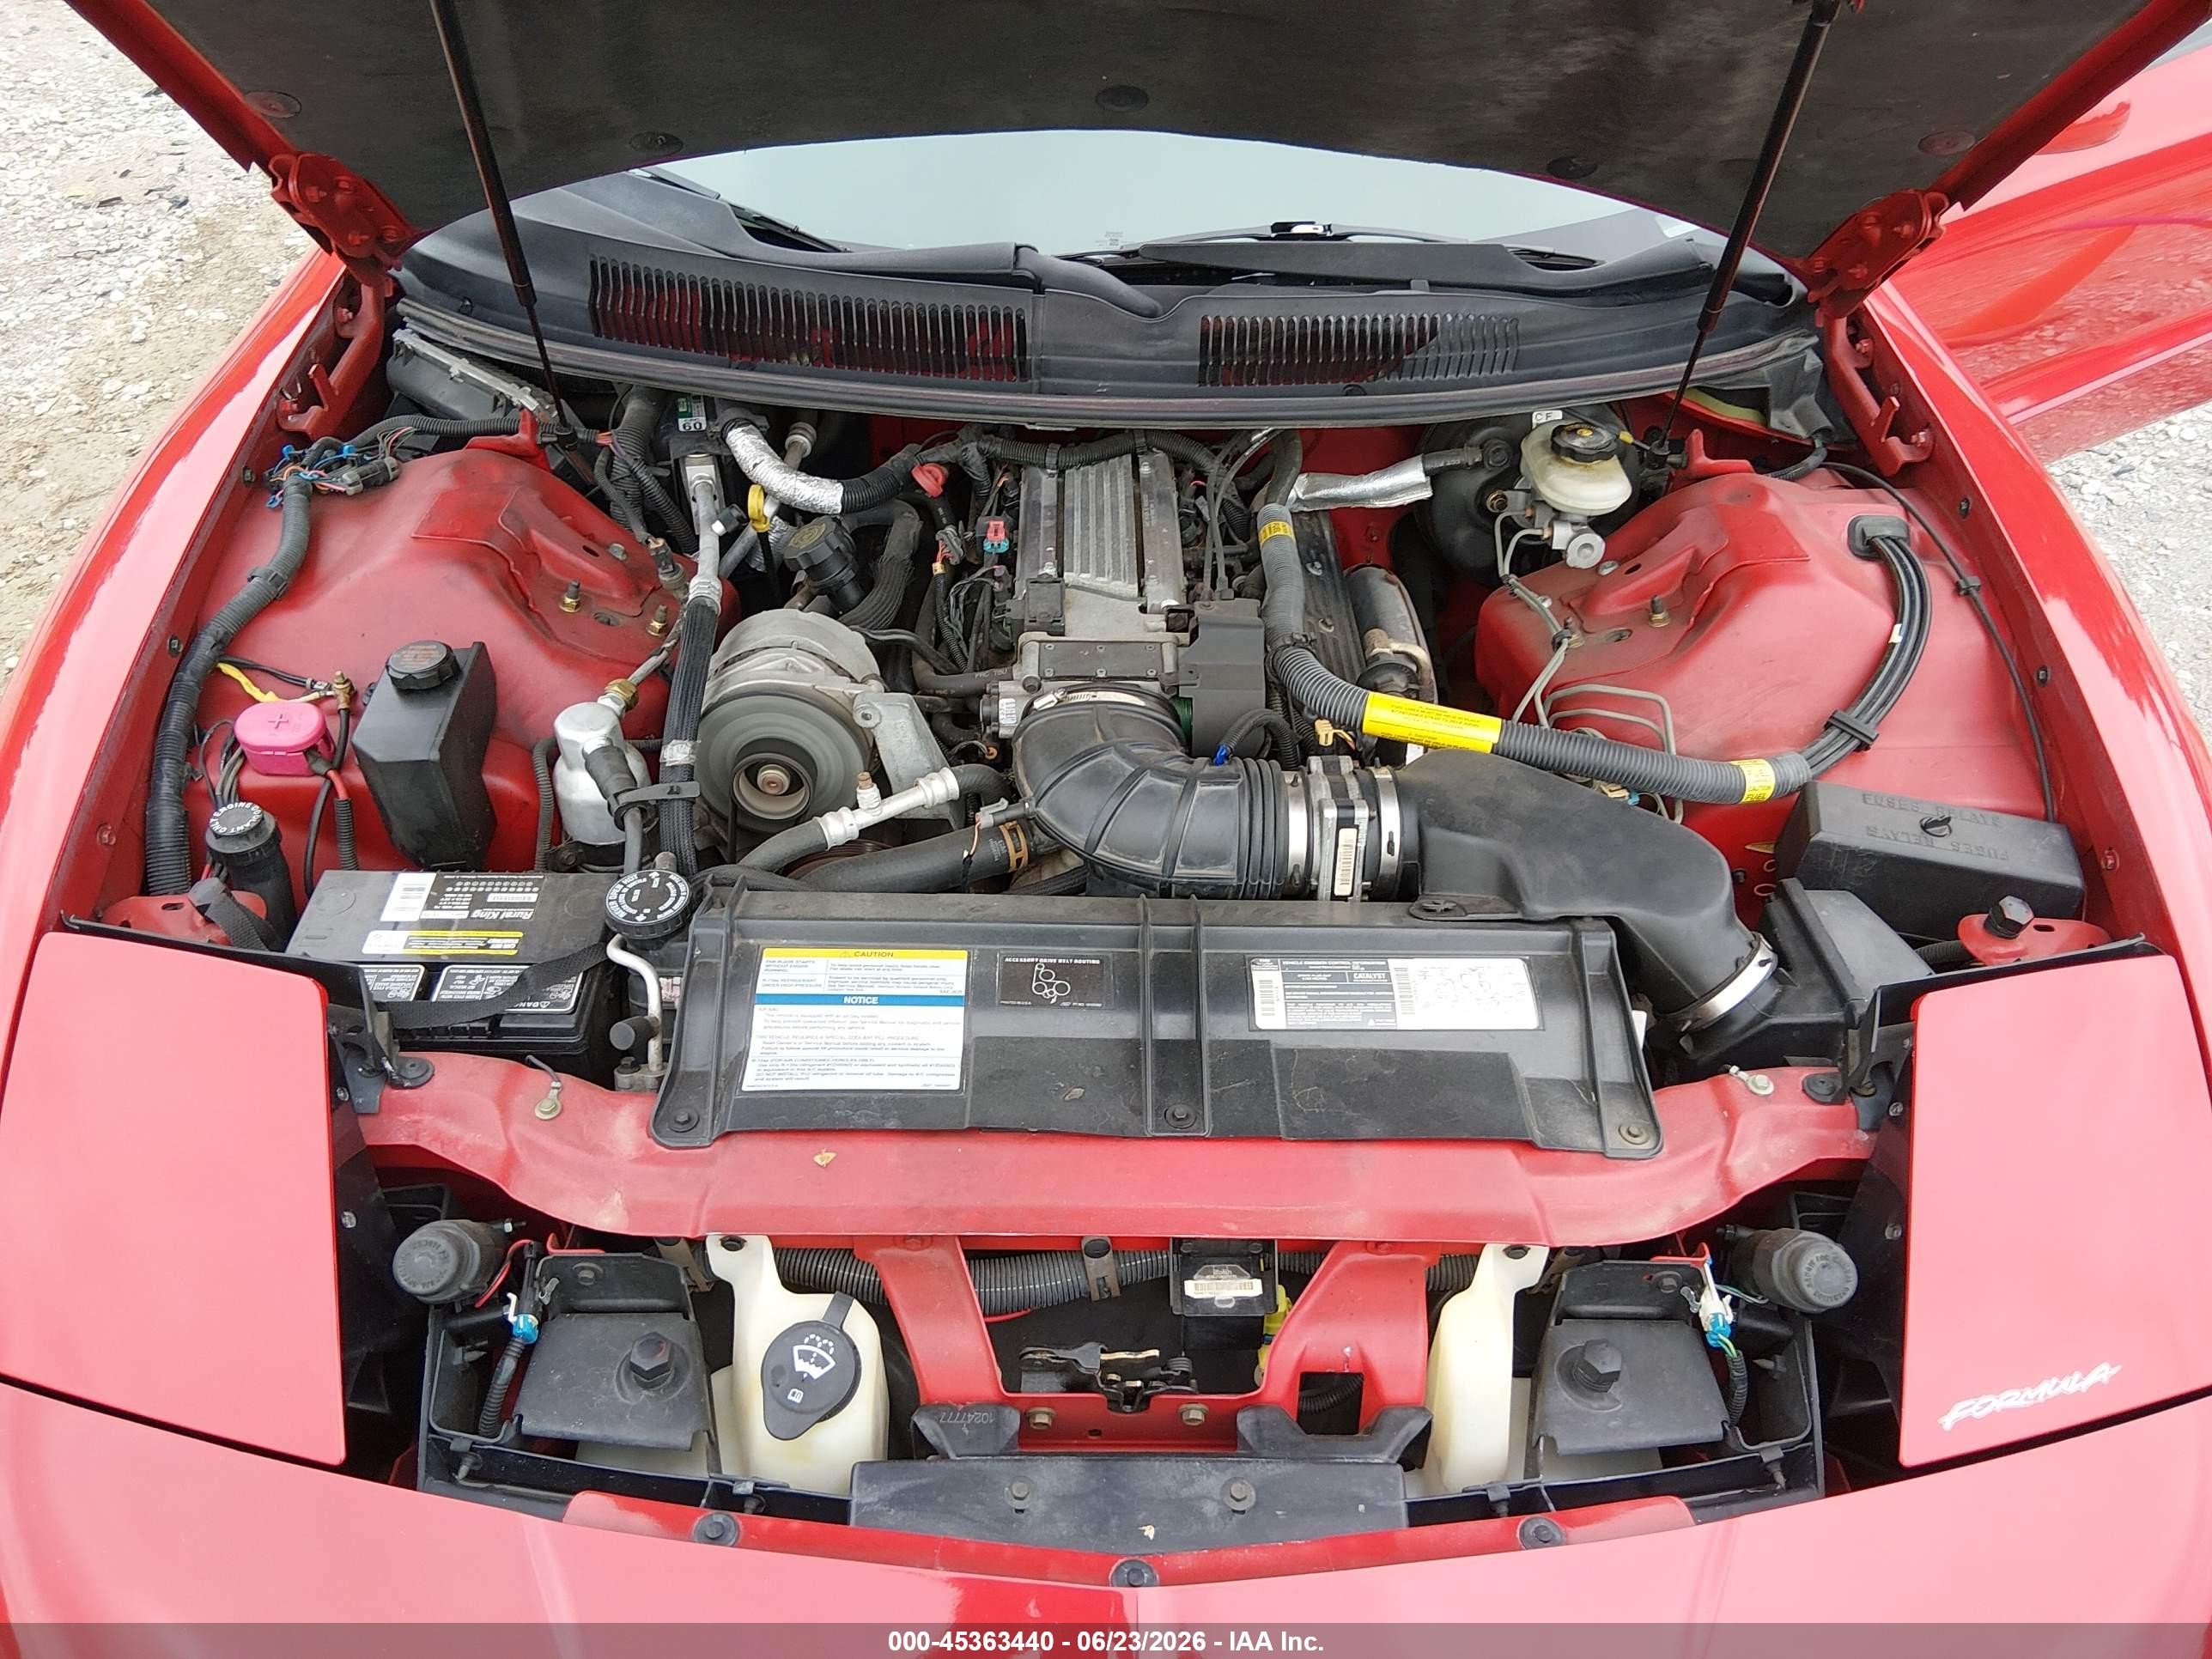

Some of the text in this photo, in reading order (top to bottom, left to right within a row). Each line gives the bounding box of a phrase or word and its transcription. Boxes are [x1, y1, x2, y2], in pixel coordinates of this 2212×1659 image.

[683, 422, 702, 431] 60
[212, 801, 253, 817] ENGINE
[1862, 793, 2002, 826] FUSES RELAYS
[501, 910, 534, 920] Rural
[843, 995, 879, 1005] NOTICE
[1937, 1362, 2123, 1431] FORMULA
[939, 1413, 995, 1424] 10247777
